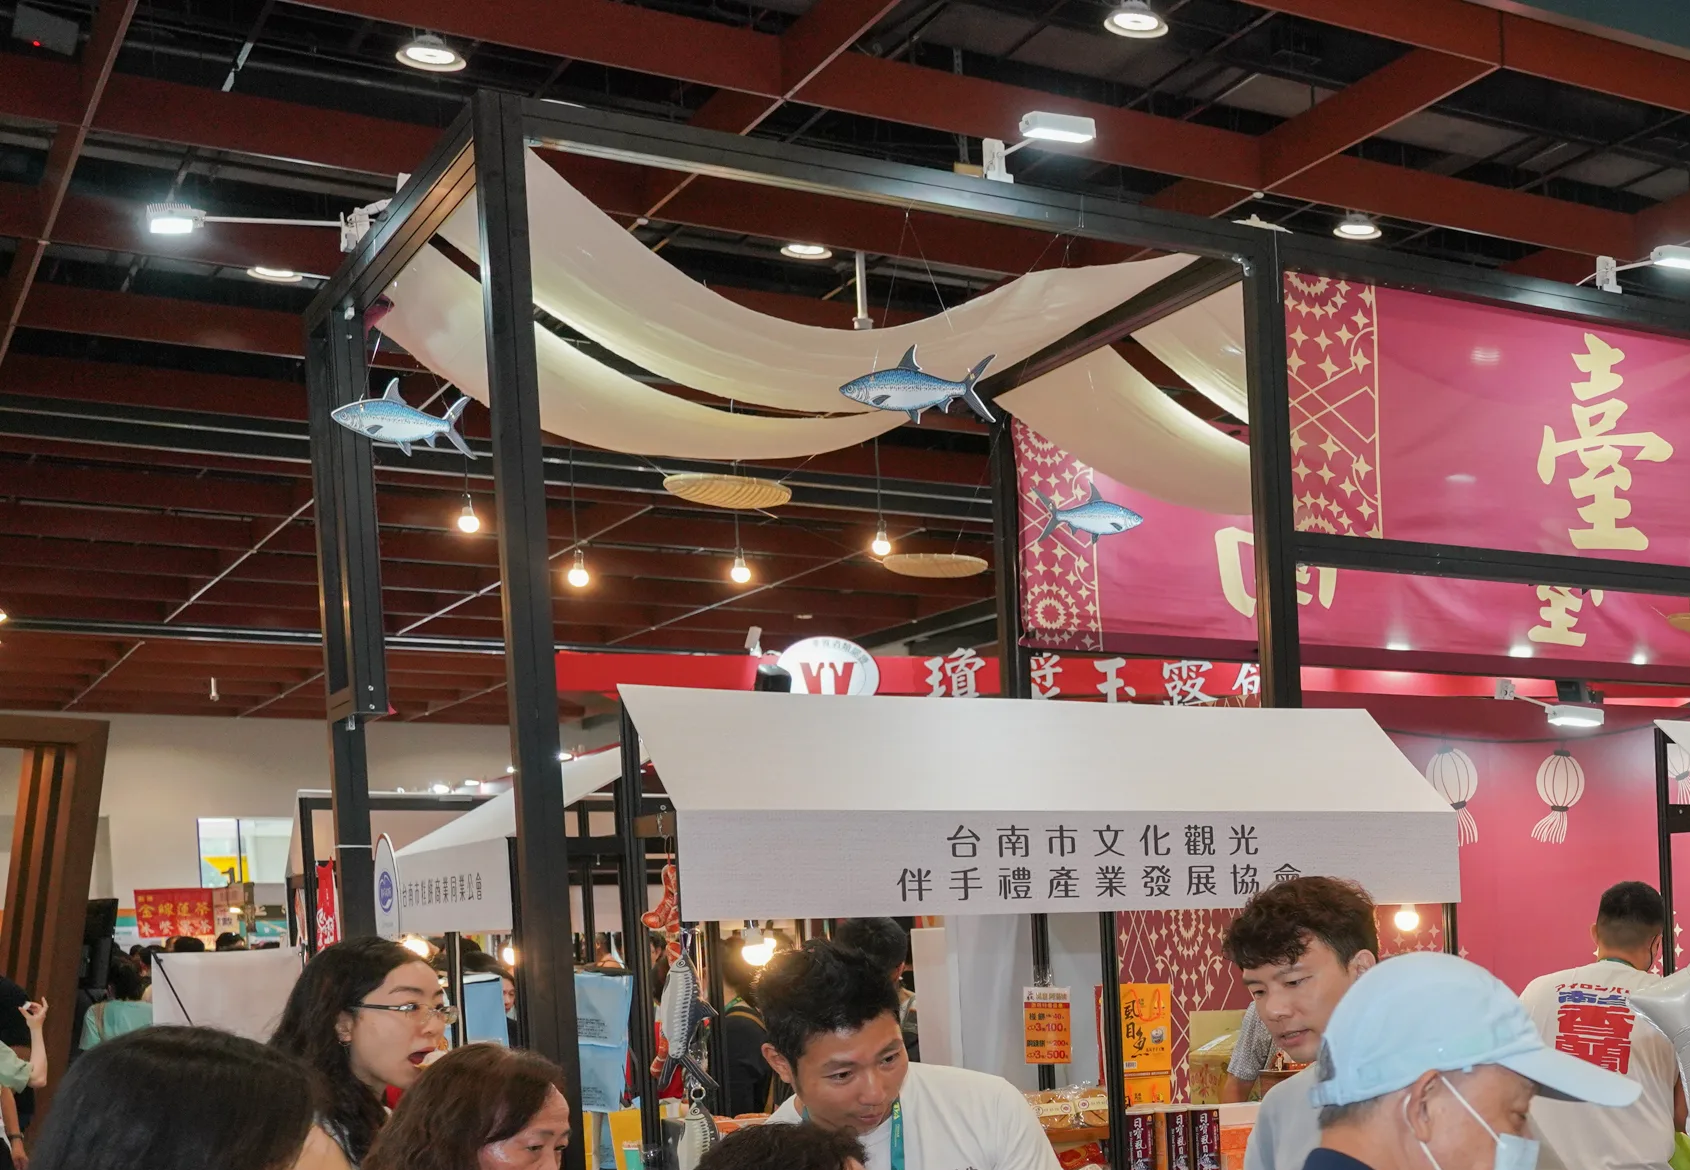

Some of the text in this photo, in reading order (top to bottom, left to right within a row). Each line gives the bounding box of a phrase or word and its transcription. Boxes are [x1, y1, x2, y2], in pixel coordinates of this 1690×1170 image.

[946, 823, 1261, 860] 台南市文化觀光
